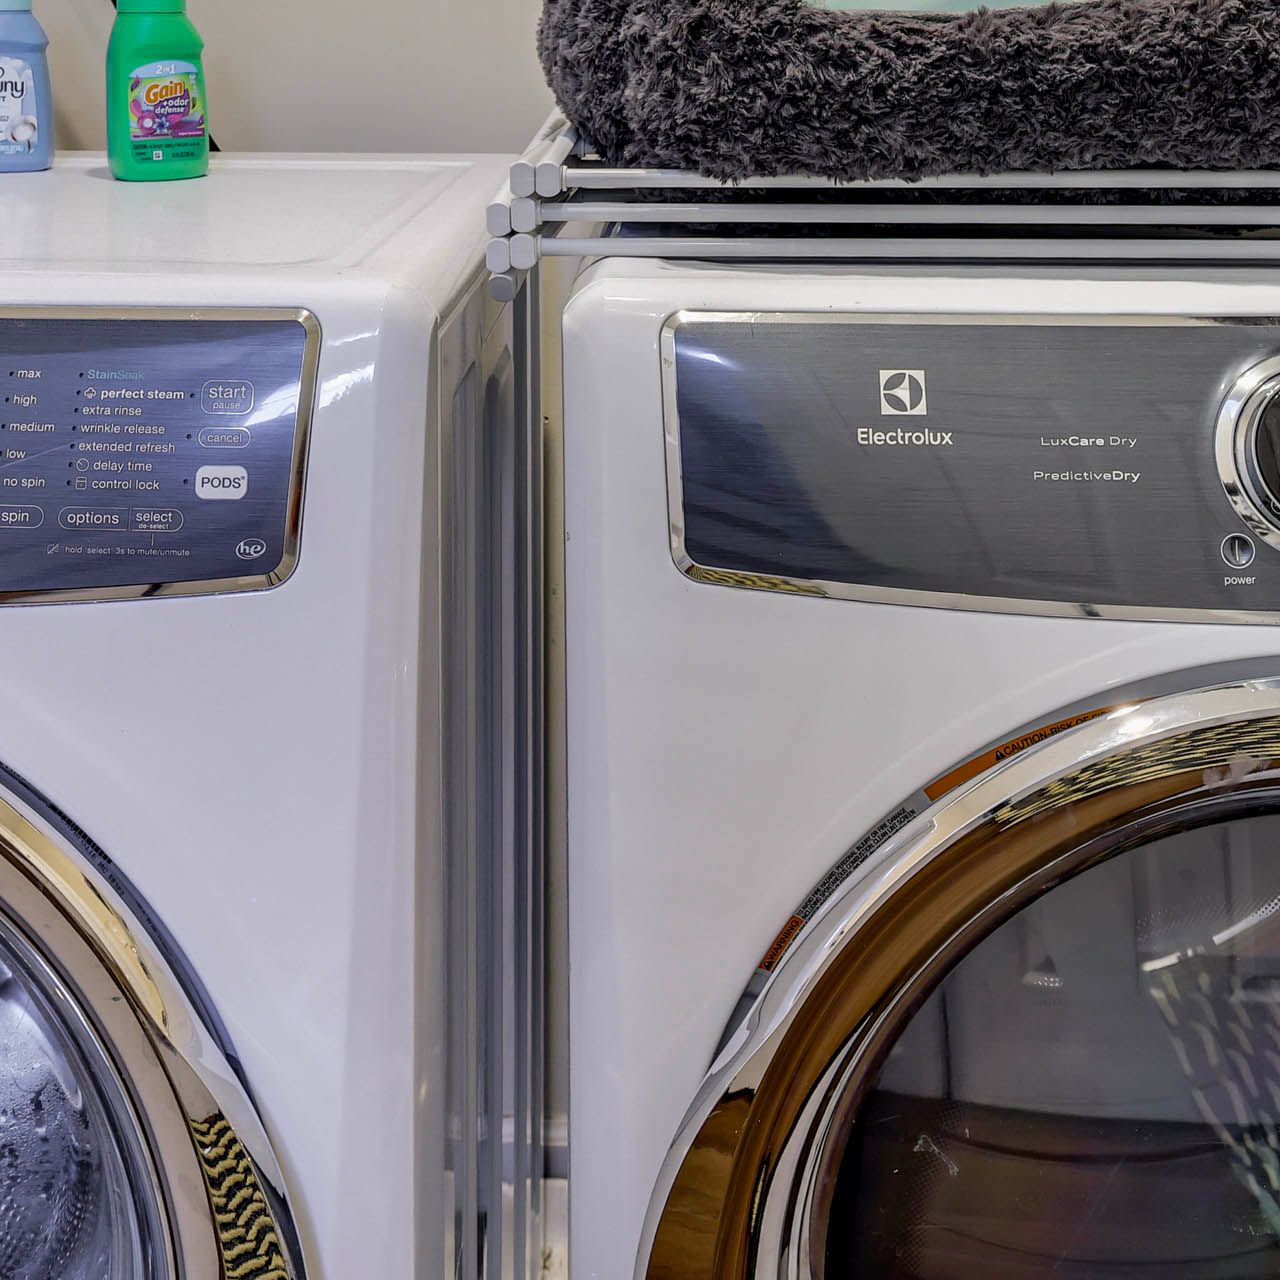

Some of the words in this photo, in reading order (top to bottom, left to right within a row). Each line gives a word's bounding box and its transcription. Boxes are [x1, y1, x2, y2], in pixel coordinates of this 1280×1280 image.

[145, 80, 186, 105] Gain
[155, 106, 185, 114] defense
[17, 370, 42, 378] max
[100, 388, 145, 401] perfect
[146, 389, 185, 400] steam
[208, 384, 247, 400] start
[13, 394, 37, 407] high
[212, 401, 241, 411] pause
[82, 405, 111, 416] extra
[114, 404, 142, 416] rinse
[9, 421, 55, 432] medium
[80, 422, 121, 434] wrinkle
[124, 423, 165, 434] release
[207, 432, 242, 444] cancel
[857, 428, 953, 445] Electrolux
[1040, 436, 1105, 446] LuxCare
[1109, 436, 1137, 448] Dry
[78, 441, 133, 452] extended
[135, 441, 175, 454] refresh
[6, 448, 26, 460] low
[93, 459, 124, 473] delay
[127, 461, 153, 472] time
[3, 478, 18, 487] no
[21, 476, 45, 489] spin
[1033, 470, 1141, 483] PredictiveDry
[91, 479, 132, 490] control
[135, 479, 160, 490] lock
[1, 509, 29, 525] spin
[67, 511, 119, 526] options
[135, 511, 172, 522] select
[65, 546, 83, 554] hold
[127, 547, 136, 555] to
[1224, 576, 1256, 586] power
[770, 919, 800, 965] WARNING
